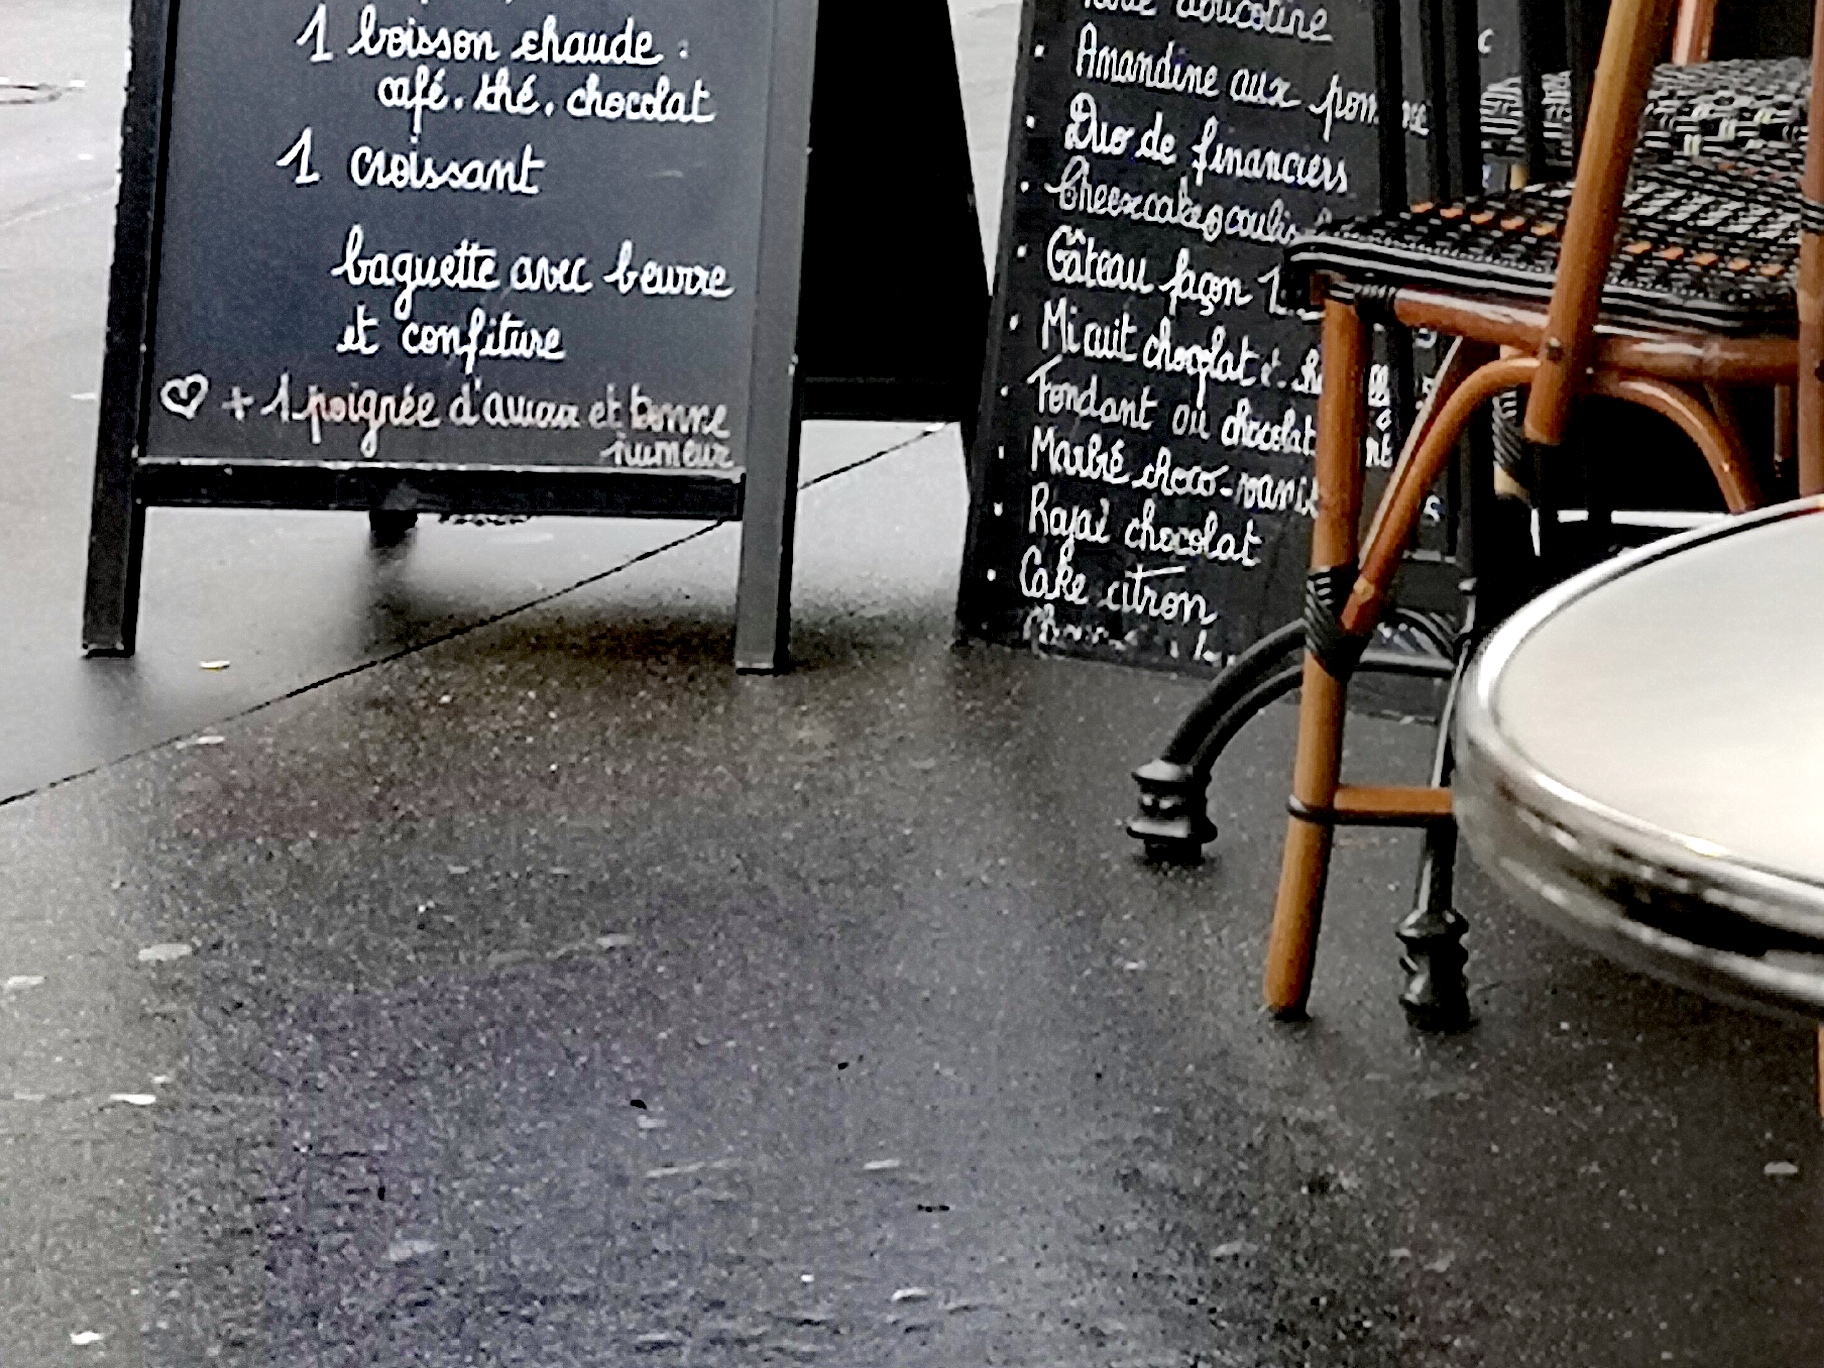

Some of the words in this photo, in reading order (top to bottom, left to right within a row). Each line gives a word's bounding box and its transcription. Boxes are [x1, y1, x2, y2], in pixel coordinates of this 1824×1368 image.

[296, 3, 333, 64] 1
[346, 3, 500, 62] boisson
[509, 13, 664, 66] chaude
[1075, 21, 1220, 98] Amandine
[1229, 68, 1303, 109] aux
[566, 72, 715, 123] chocolat
[275, 126, 320, 186] 1
[350, 133, 547, 196] croissant
[1135, 111, 1177, 166] de
[1191, 116, 1349, 194] financiers
[331, 222, 500, 319] baguette
[506, 258, 592, 294] avec
[603, 238, 735, 299] beurre
[1047, 225, 1155, 295] Gâteau
[1158, 247, 1255, 317] façon
[336, 308, 379, 355] et
[400, 308, 566, 374] confiture
[588, 384, 624, 430] et
[1026, 354, 1158, 431] Fondant
[1124, 499, 1266, 567] chocolat
[1019, 532, 1089, 605] Cake
[1096, 563, 1219, 626] citron
